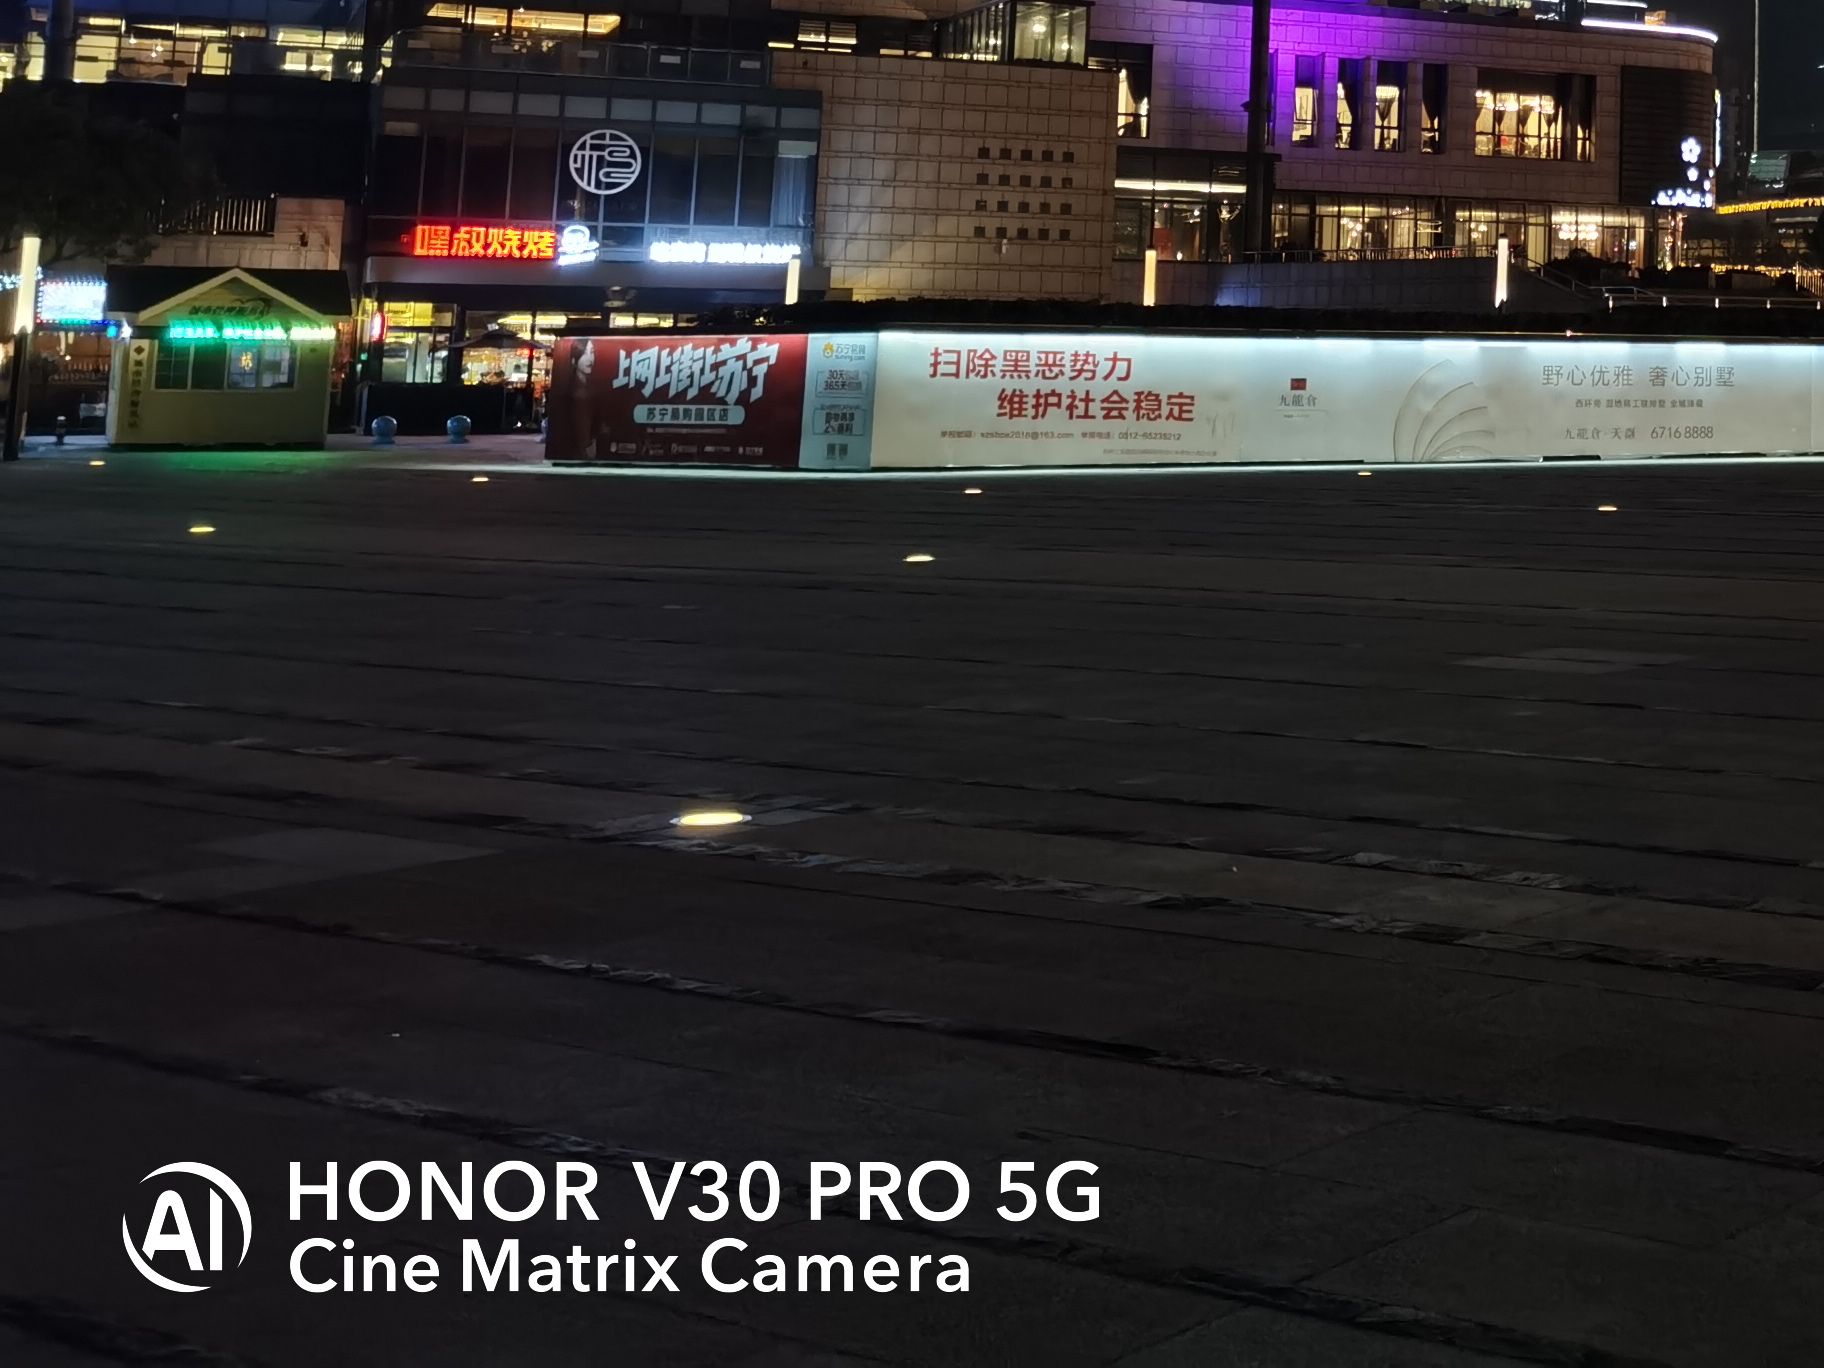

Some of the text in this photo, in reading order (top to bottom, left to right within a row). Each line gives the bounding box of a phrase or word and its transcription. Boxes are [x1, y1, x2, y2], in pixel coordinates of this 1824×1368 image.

[414, 224, 557, 259] 嘿叔烧烤
[613, 336, 780, 407] 上网上街上苏宁
[929, 347, 1133, 382] 扫除黑恶势力
[1541, 364, 1735, 388] 野心优雅 奢心别墅
[996, 388, 1197, 422] 维护社会稳定
